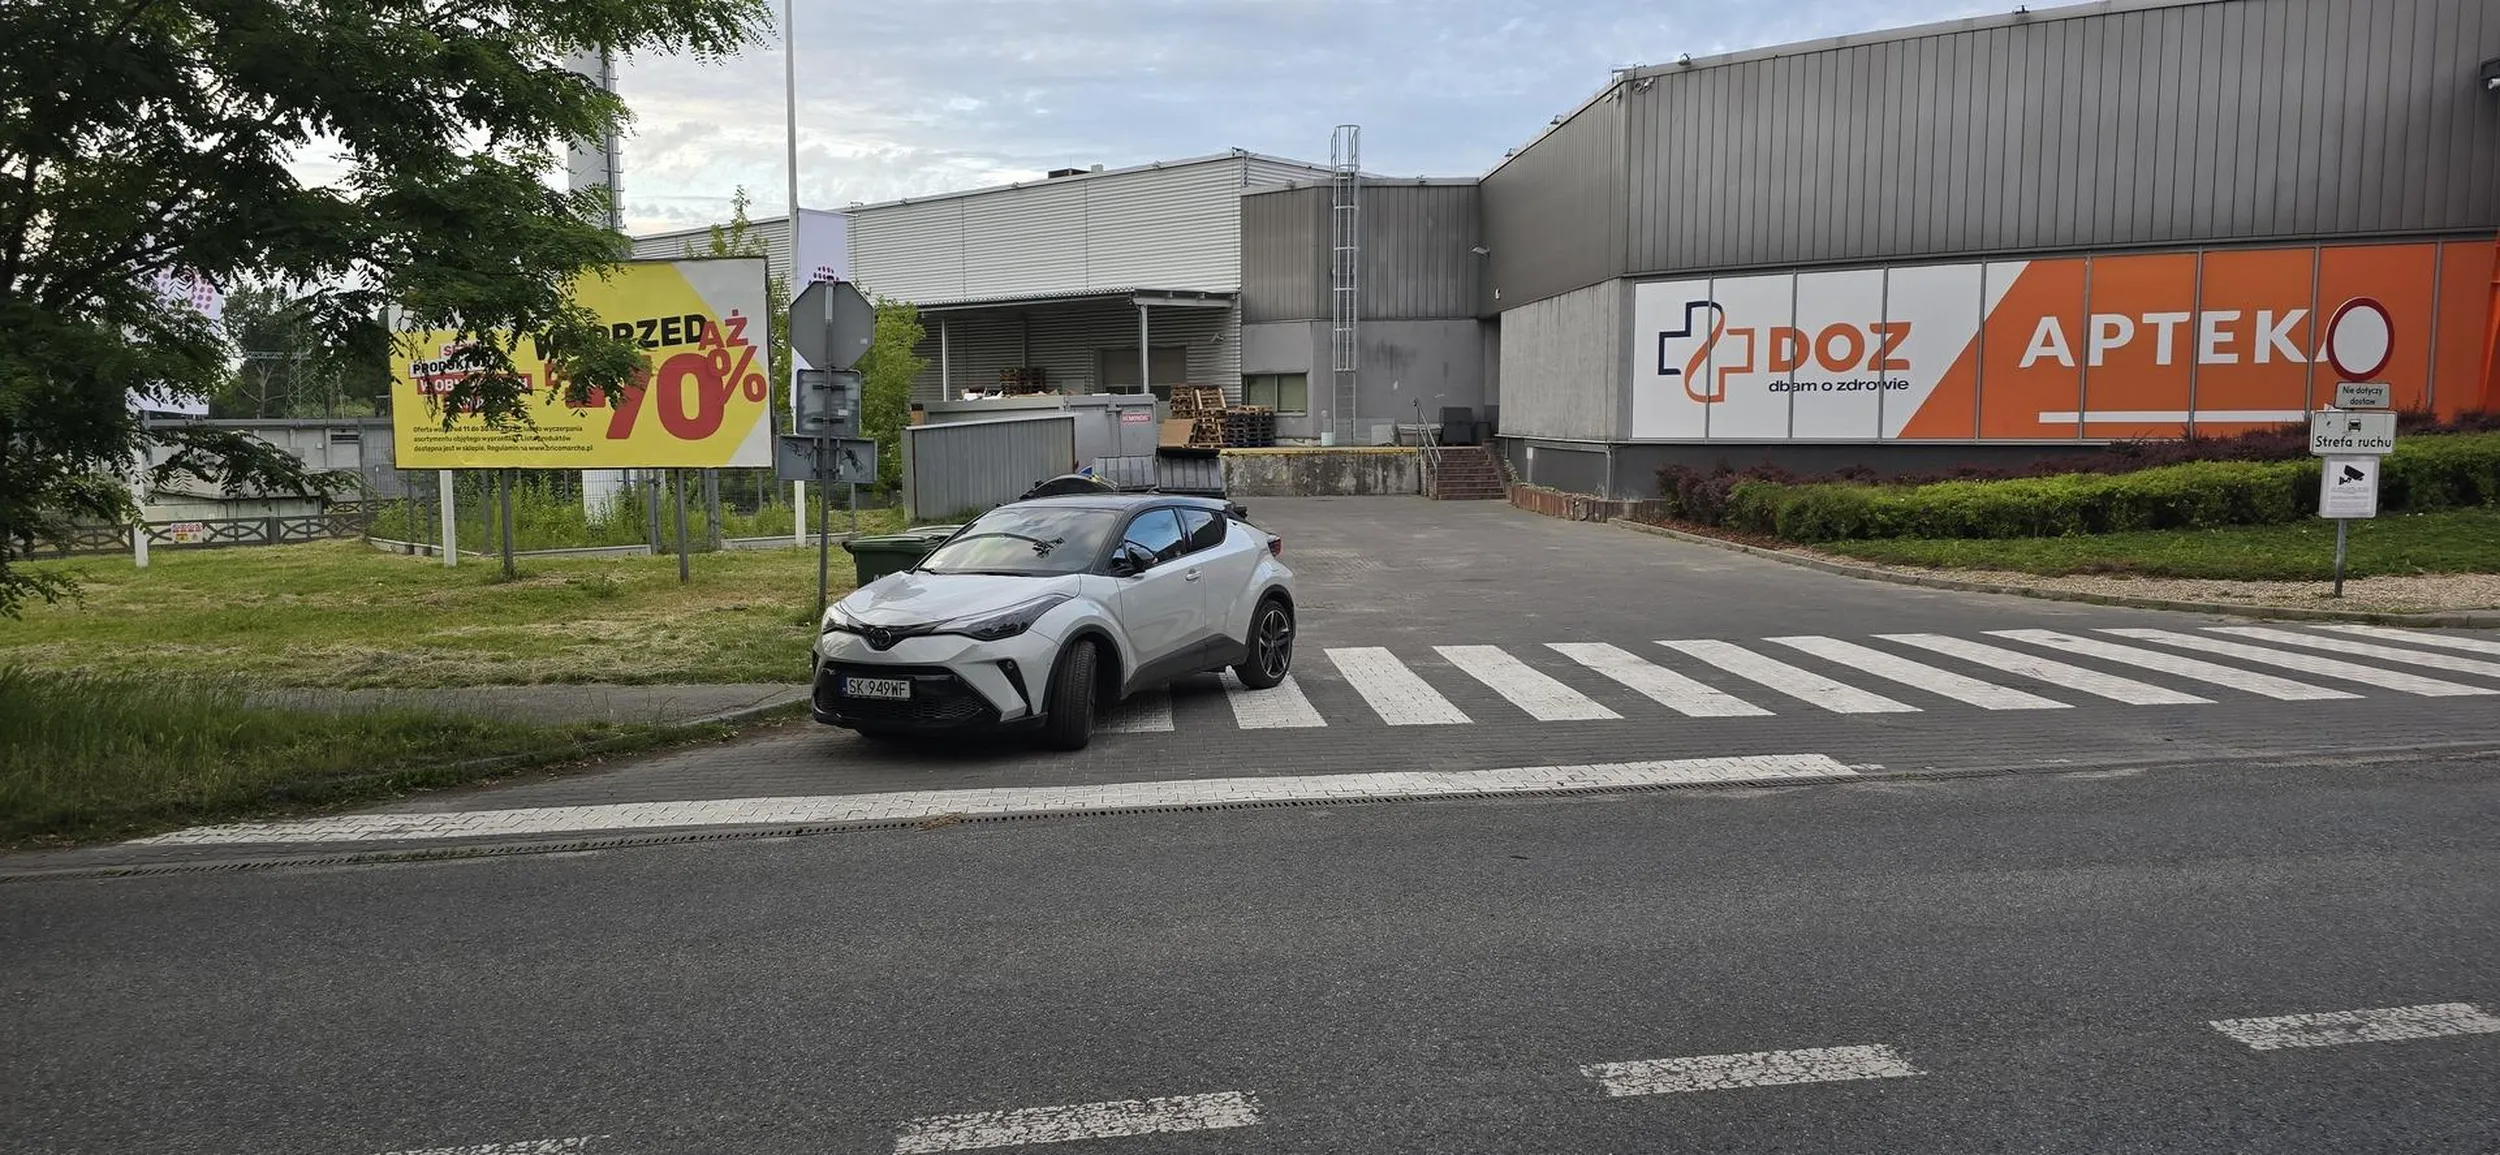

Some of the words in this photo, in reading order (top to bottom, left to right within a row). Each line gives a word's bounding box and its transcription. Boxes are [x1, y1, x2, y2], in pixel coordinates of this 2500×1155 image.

[2019, 309, 2328, 368] APTEK
[1769, 321, 1912, 373] DOZ
[1769, 379, 1817, 392] dbam
[1821, 381, 1833, 391] o
[1836, 377, 1909, 391] zdrowie
[2342, 385, 2354, 394] Nie
[2356, 386, 2384, 396] dotyczy
[2315, 435, 2352, 447] Strefa
[2357, 435, 2392, 447] ruchu
[849, 679, 864, 694] SK
